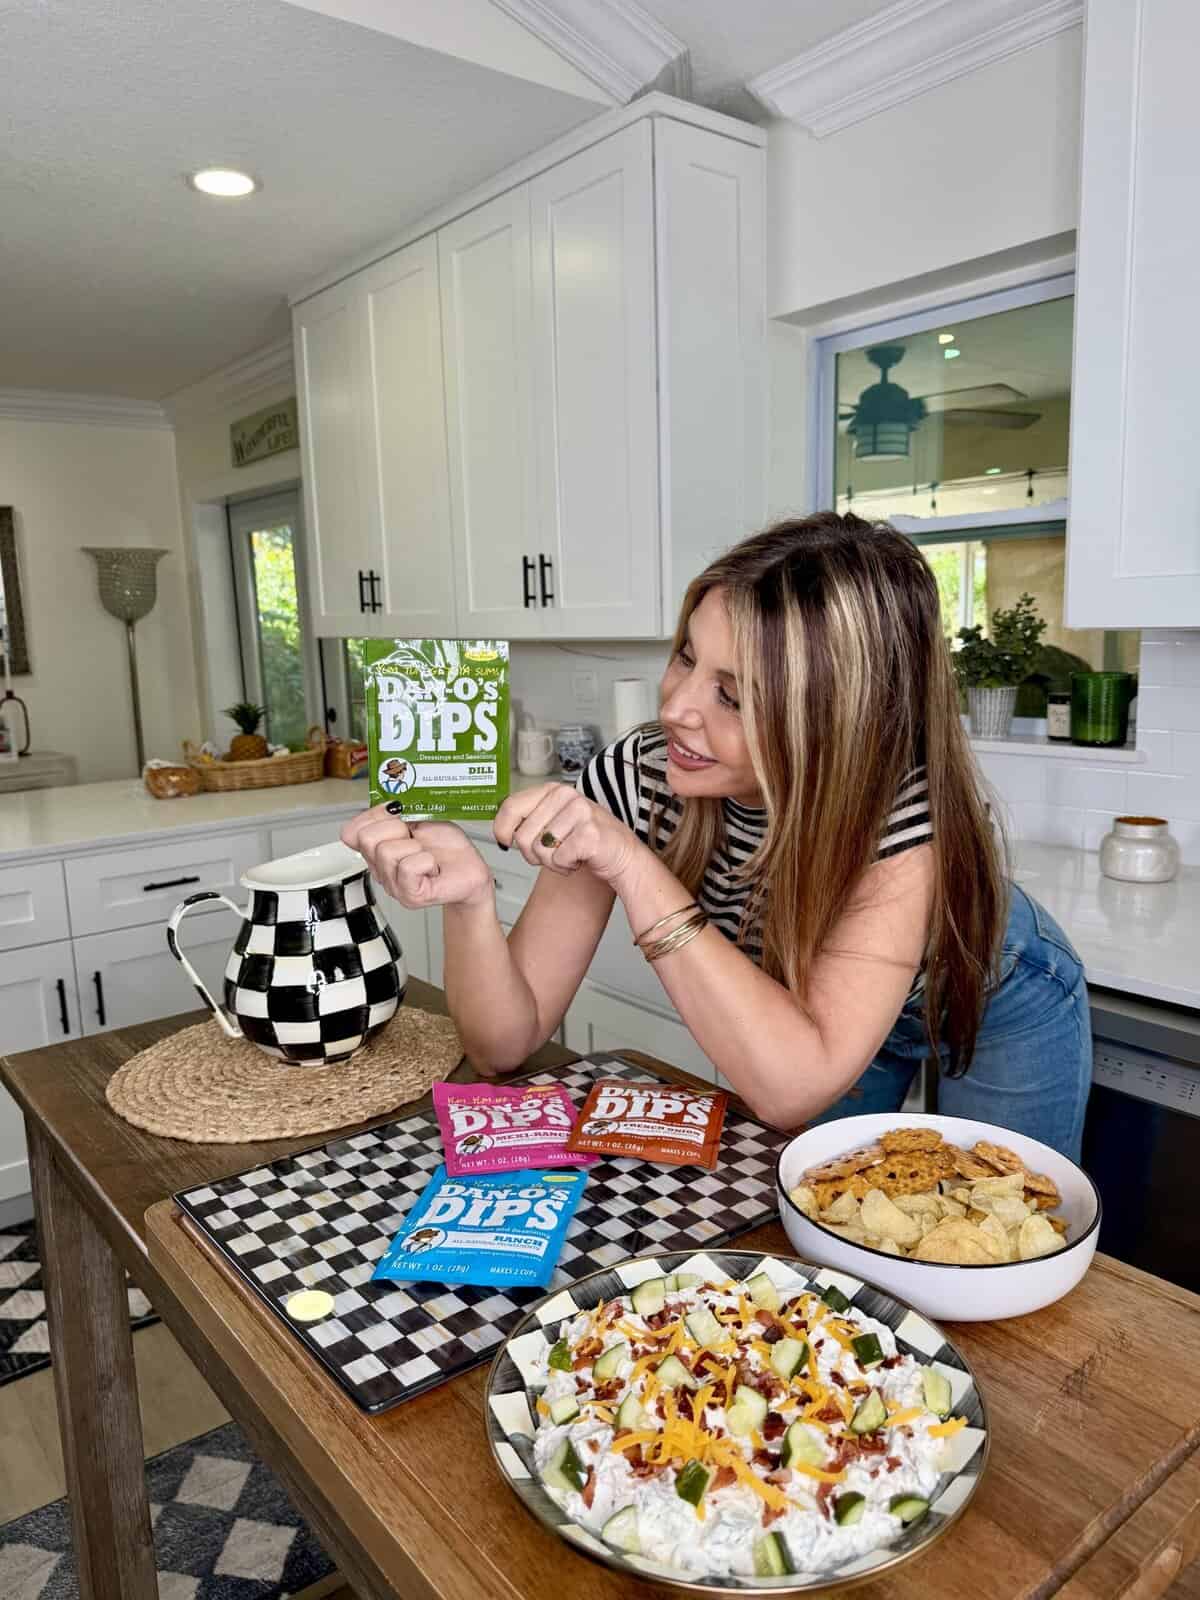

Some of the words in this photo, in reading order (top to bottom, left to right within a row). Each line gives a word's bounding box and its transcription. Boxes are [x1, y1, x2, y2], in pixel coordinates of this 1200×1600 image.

[378, 701, 498, 752] DIPS
[468, 766, 495, 775] DILL
[451, 1104, 572, 1138] DIPS
[589, 1097, 710, 1126] DIPS
[436, 1184, 570, 1201] DAN-O'S
[414, 1197, 562, 1230] DIPS
[494, 1235, 543, 1247] RANCH
